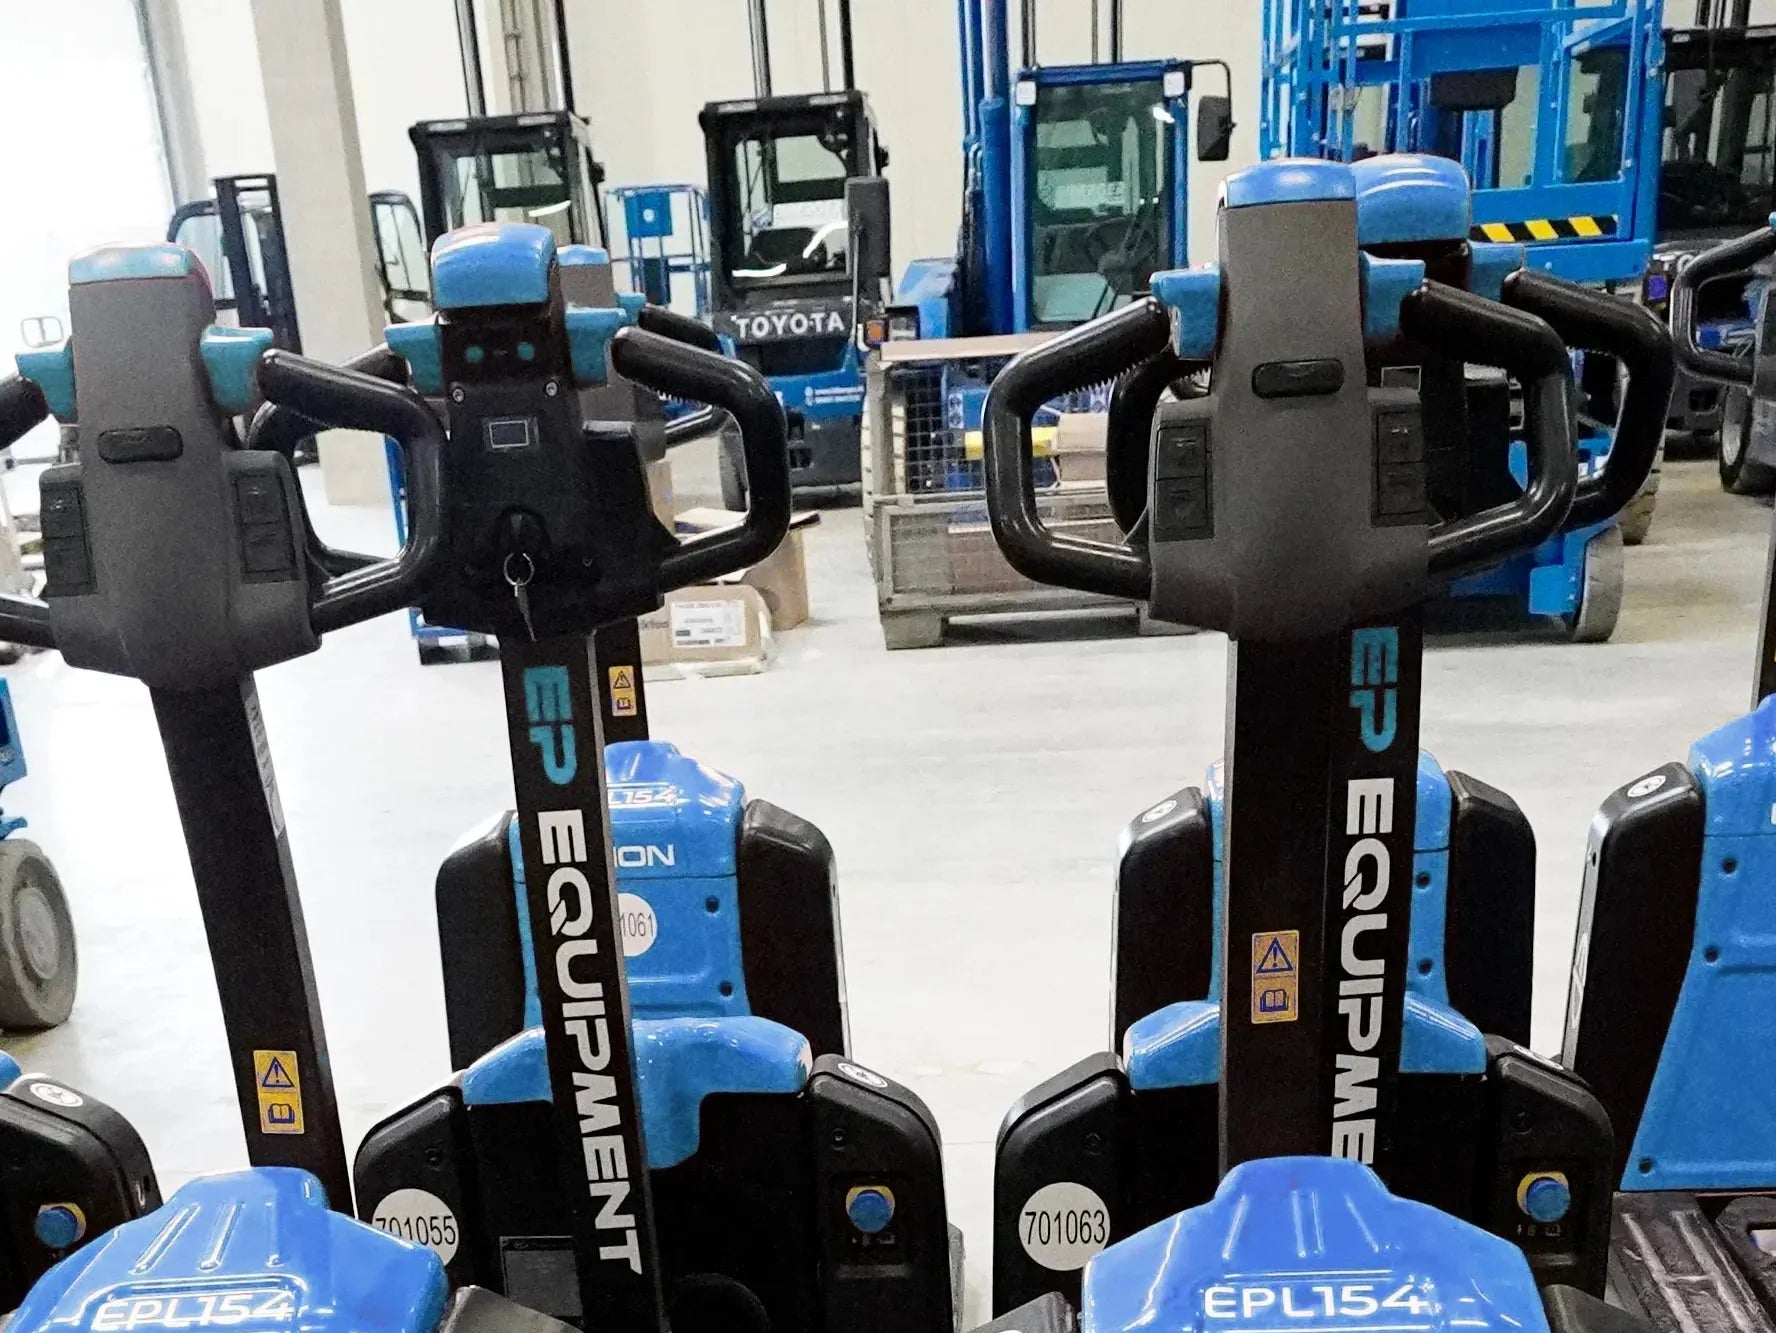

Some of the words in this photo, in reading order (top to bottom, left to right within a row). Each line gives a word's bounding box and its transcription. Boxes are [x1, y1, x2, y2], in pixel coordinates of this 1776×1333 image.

[736, 312, 845, 338] TOYOTA
[1349, 627, 1399, 753] EP
[525, 665, 578, 785] EP
[620, 912, 655, 937] 1061
[1331, 777, 1395, 1165] EQUIPME
[537, 809, 643, 1275] EQUIPMENT
[1025, 1210, 1105, 1245] 701063
[91, 1292, 293, 1331] EPL154
[1204, 1284, 1428, 1319] EPL154
